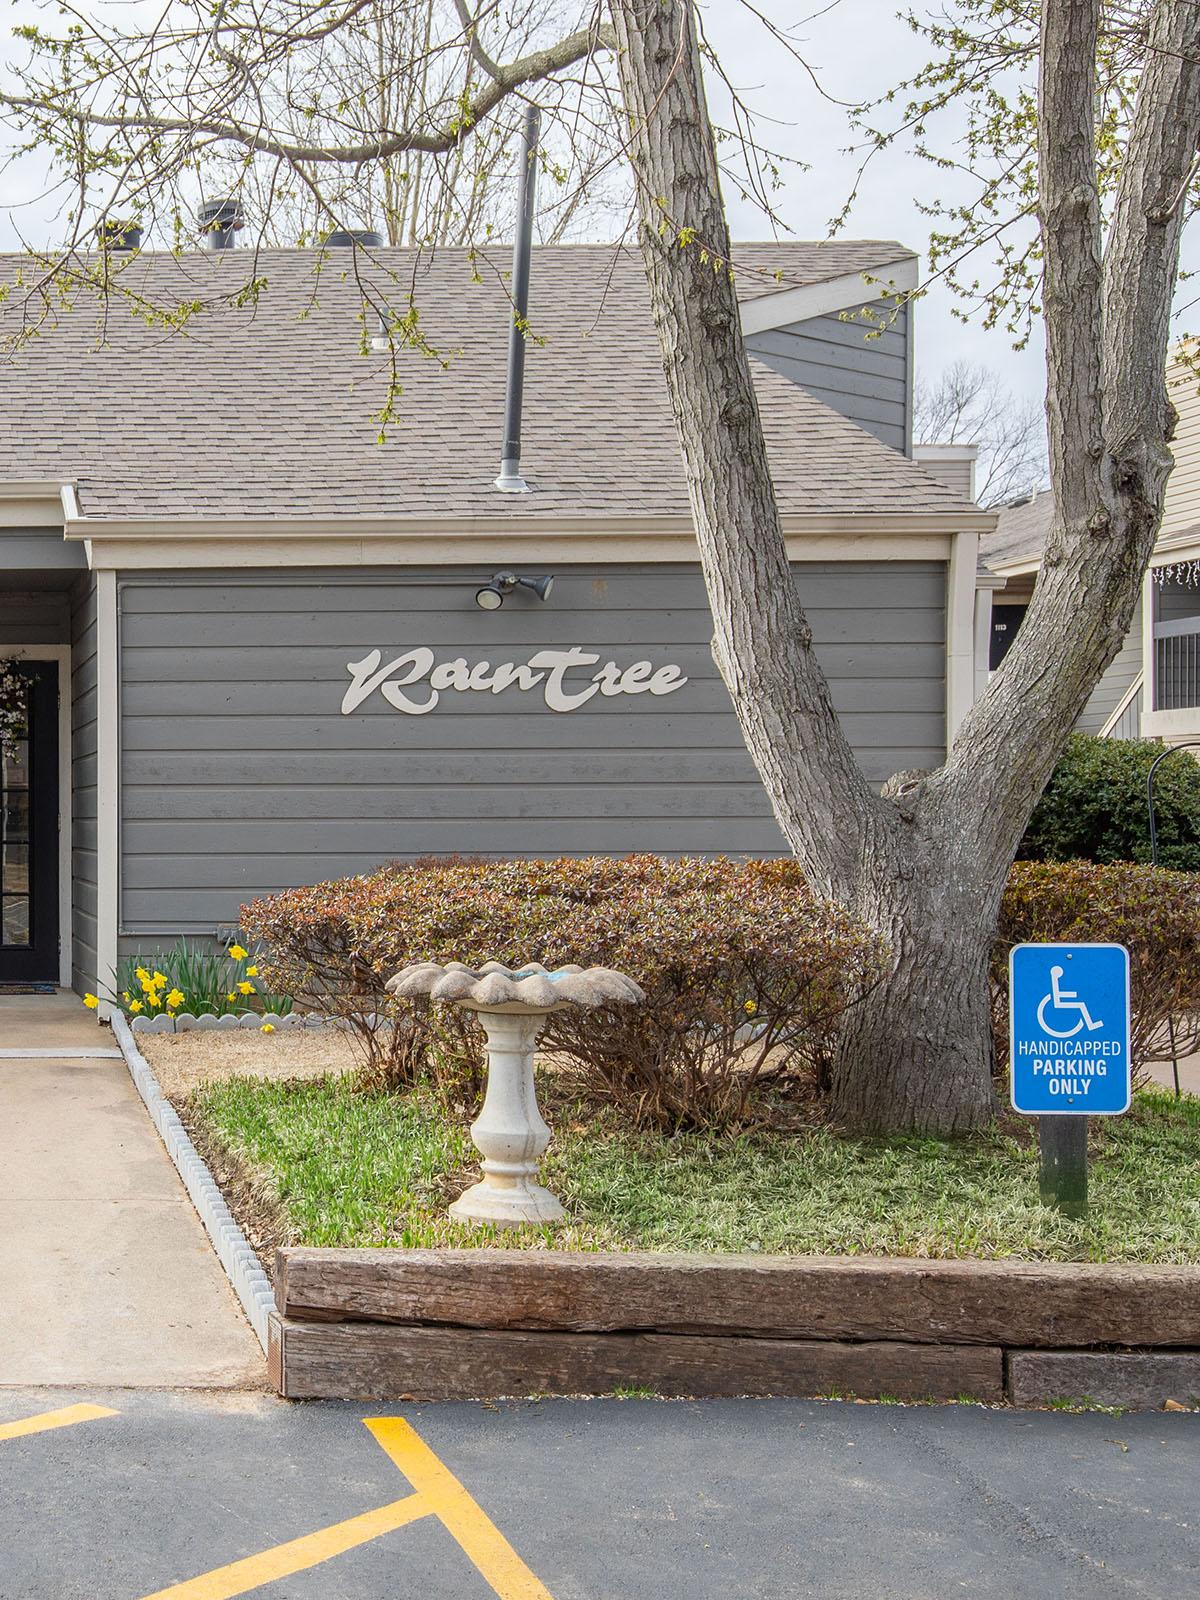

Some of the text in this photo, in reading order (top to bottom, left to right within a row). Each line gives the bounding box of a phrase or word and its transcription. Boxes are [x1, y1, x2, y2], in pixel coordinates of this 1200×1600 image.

[1019, 1041, 1121, 1056] HANDICAPPED
[1033, 1059, 1107, 1076] PARKING
[1049, 1079, 1091, 1095] ONLY
